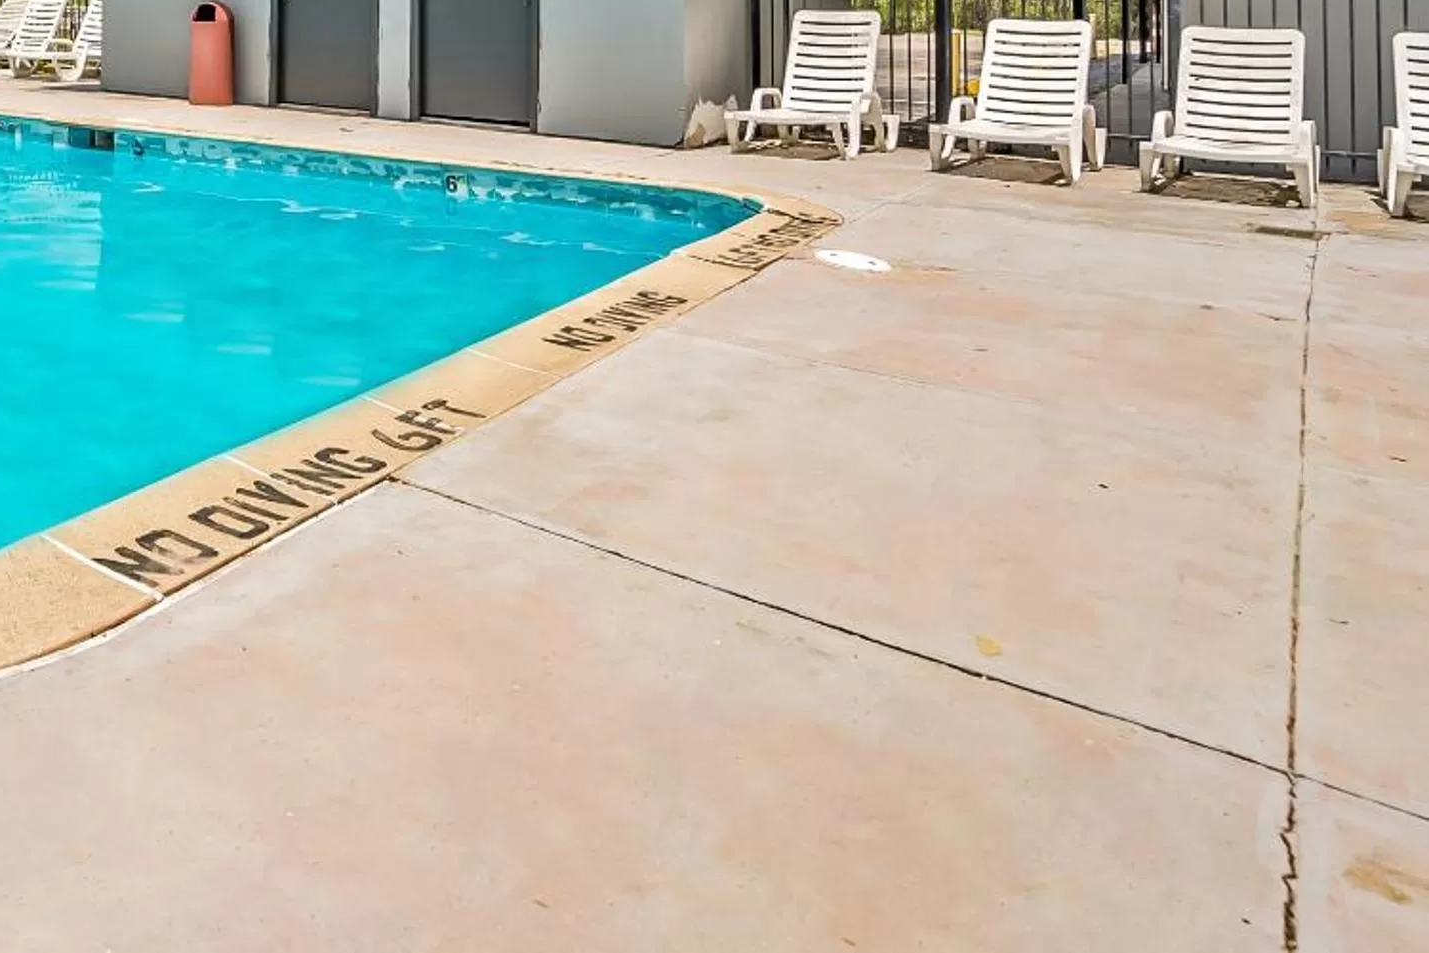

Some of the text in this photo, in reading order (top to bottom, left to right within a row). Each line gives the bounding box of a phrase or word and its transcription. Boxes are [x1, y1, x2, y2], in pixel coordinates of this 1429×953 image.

[445, 175, 458, 194] 6
[541, 290, 689, 352] NO DIVING
[90, 528, 219, 588] NO
[187, 447, 388, 541] DIVING
